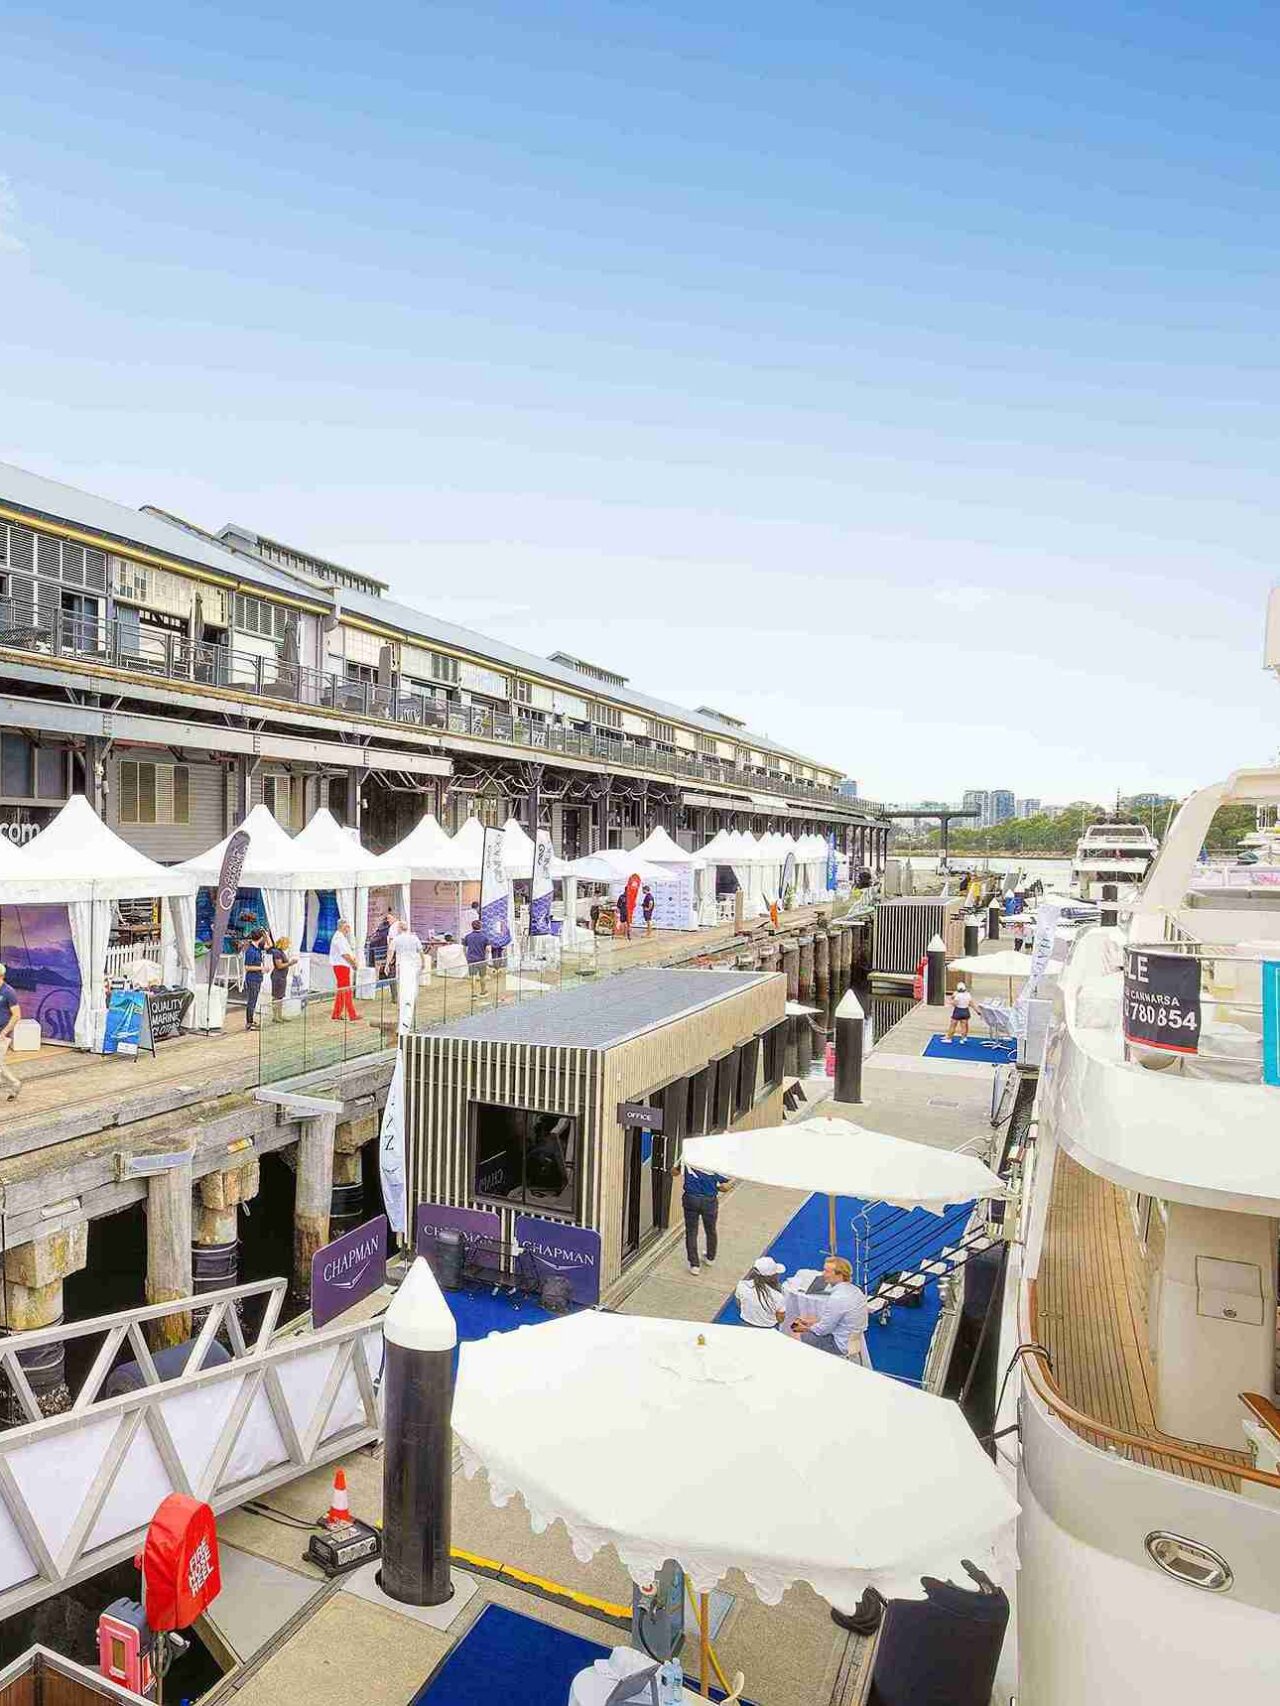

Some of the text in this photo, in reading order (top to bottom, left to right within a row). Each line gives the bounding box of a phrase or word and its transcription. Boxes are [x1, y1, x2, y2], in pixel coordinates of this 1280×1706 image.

[1124, 953, 1150, 984] LE
[152, 999, 183, 1013] QUALITY
[1130, 990, 1180, 1007] CANNARSA
[152, 1010, 181, 1027] MARINE
[626, 1111, 652, 1122] OFFICE
[323, 1234, 380, 1282] CHAPMAN
[522, 1240, 595, 1266] CHAPMAN
